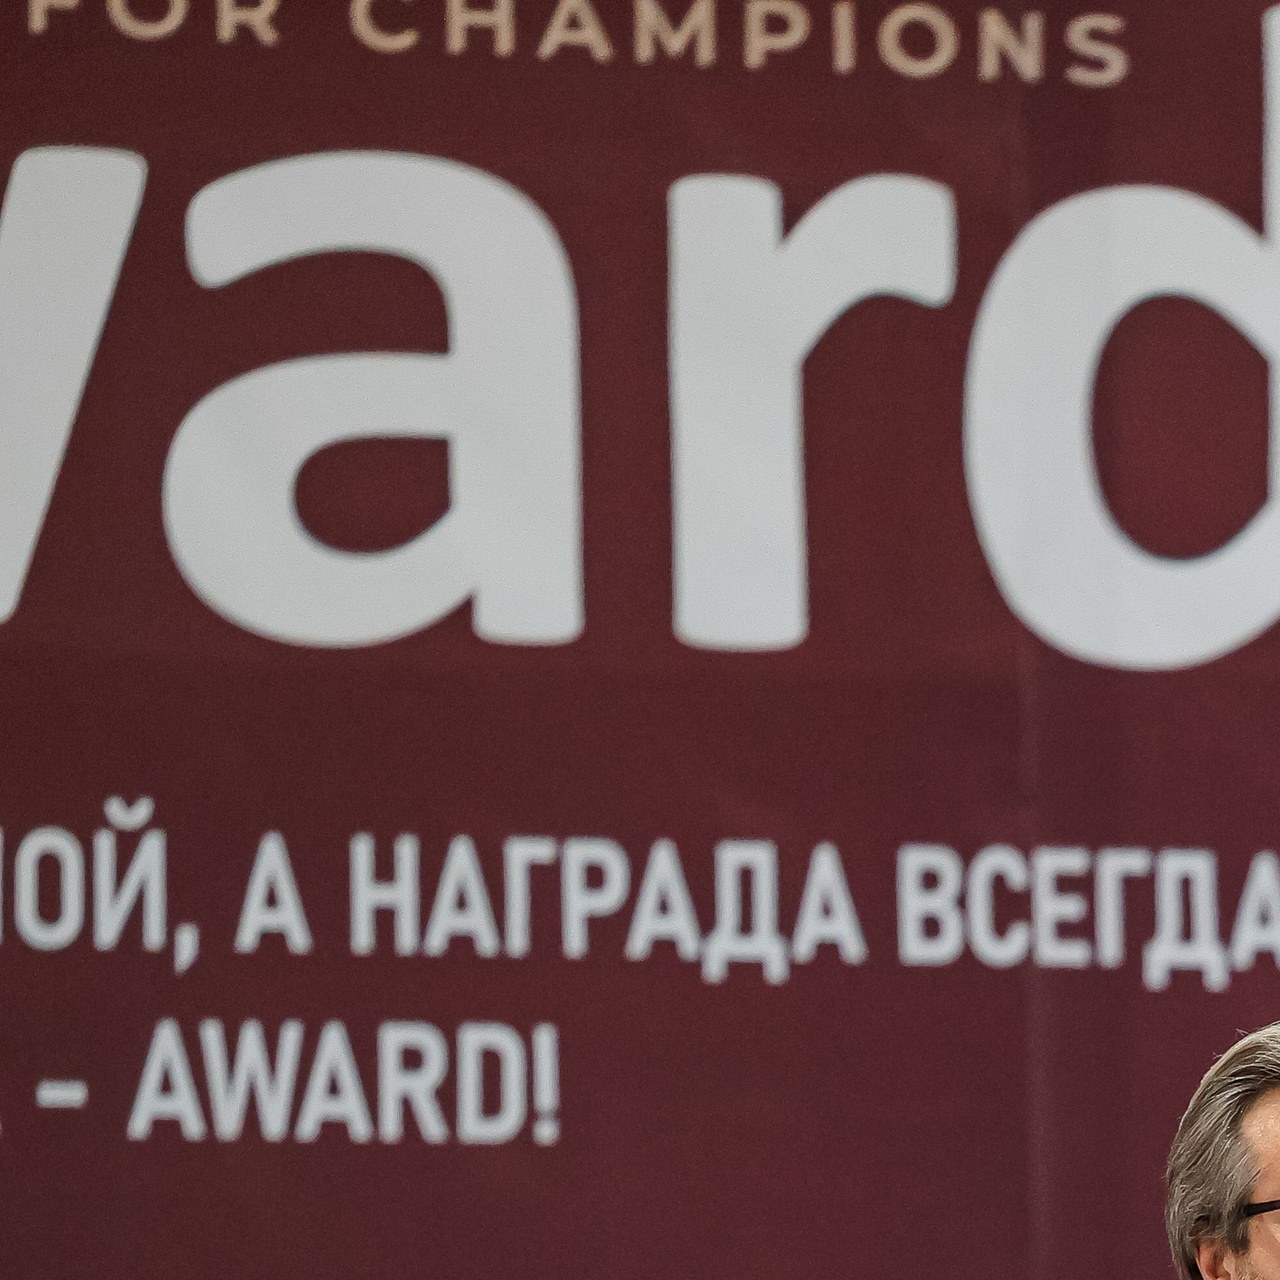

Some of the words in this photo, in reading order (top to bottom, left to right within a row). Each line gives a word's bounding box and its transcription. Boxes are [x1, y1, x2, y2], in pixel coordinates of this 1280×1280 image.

[348, 0, 1129, 88] CHAMPIONS
[0, 797, 199, 972] ОЙ,
[234, 831, 313, 955] А
[349, 833, 867, 985] НАГРАДА
[127, 1018, 561, 1145] AWARD!
